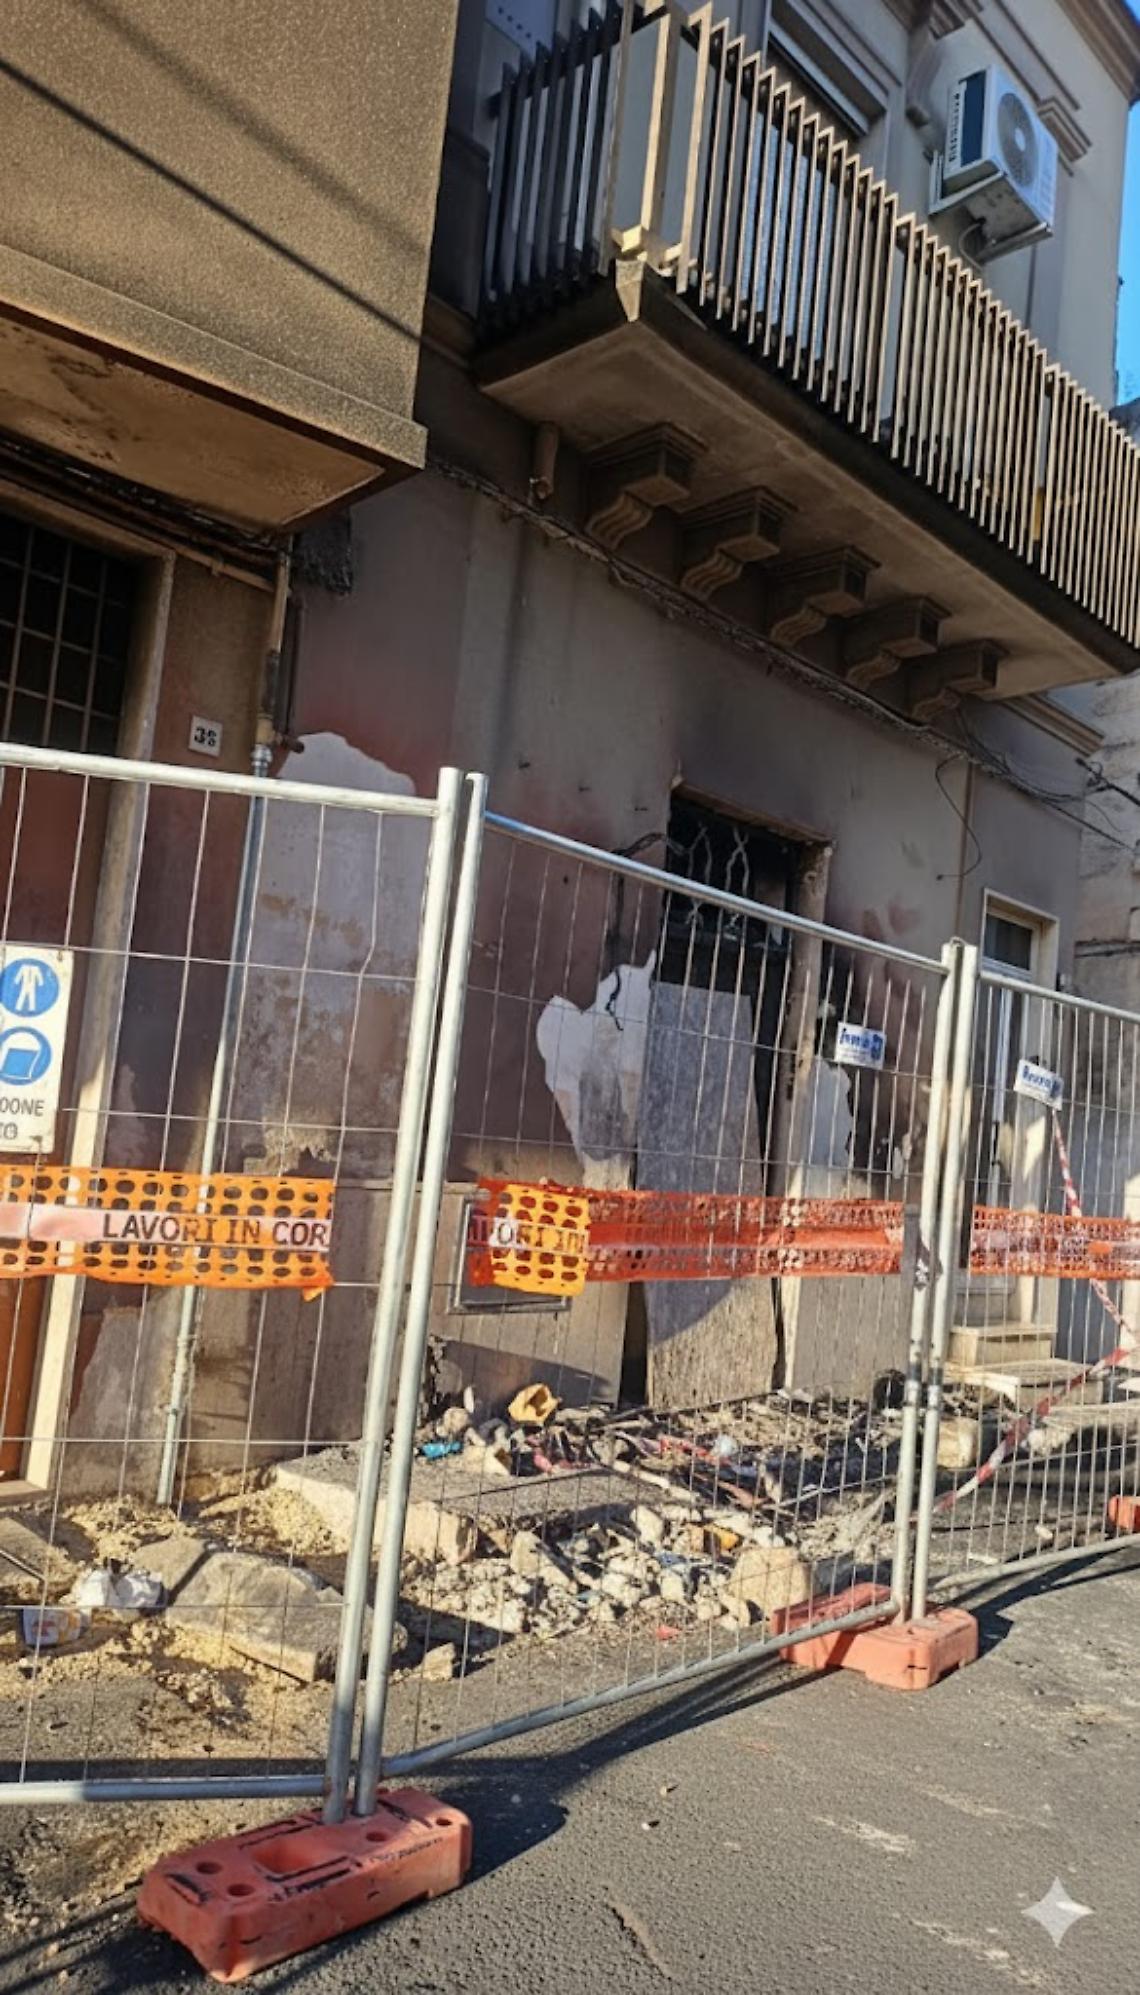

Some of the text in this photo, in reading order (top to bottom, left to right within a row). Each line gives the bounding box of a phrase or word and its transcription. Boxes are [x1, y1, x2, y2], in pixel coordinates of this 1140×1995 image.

[103, 1212, 327, 1247] LAVORI IN COR
